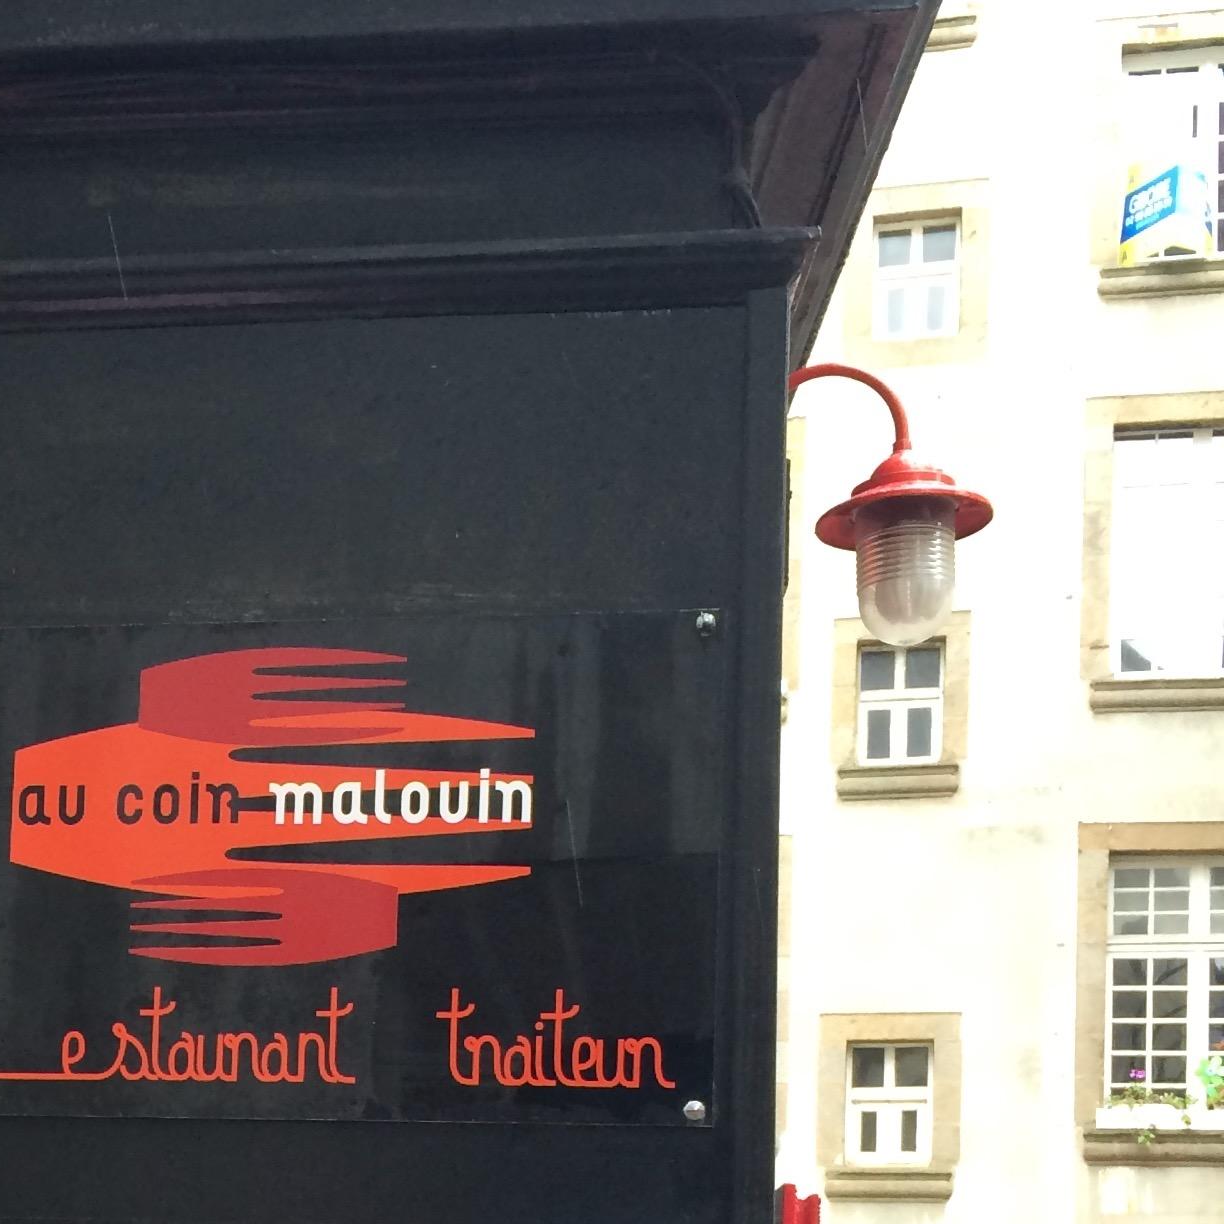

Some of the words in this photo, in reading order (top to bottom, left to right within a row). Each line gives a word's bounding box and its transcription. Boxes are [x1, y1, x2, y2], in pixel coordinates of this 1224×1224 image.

[17, 782, 87, 826] au
[115, 771, 241, 826] coin
[268, 767, 534, 825] malouin
[435, 988, 677, 1090] traiteur
